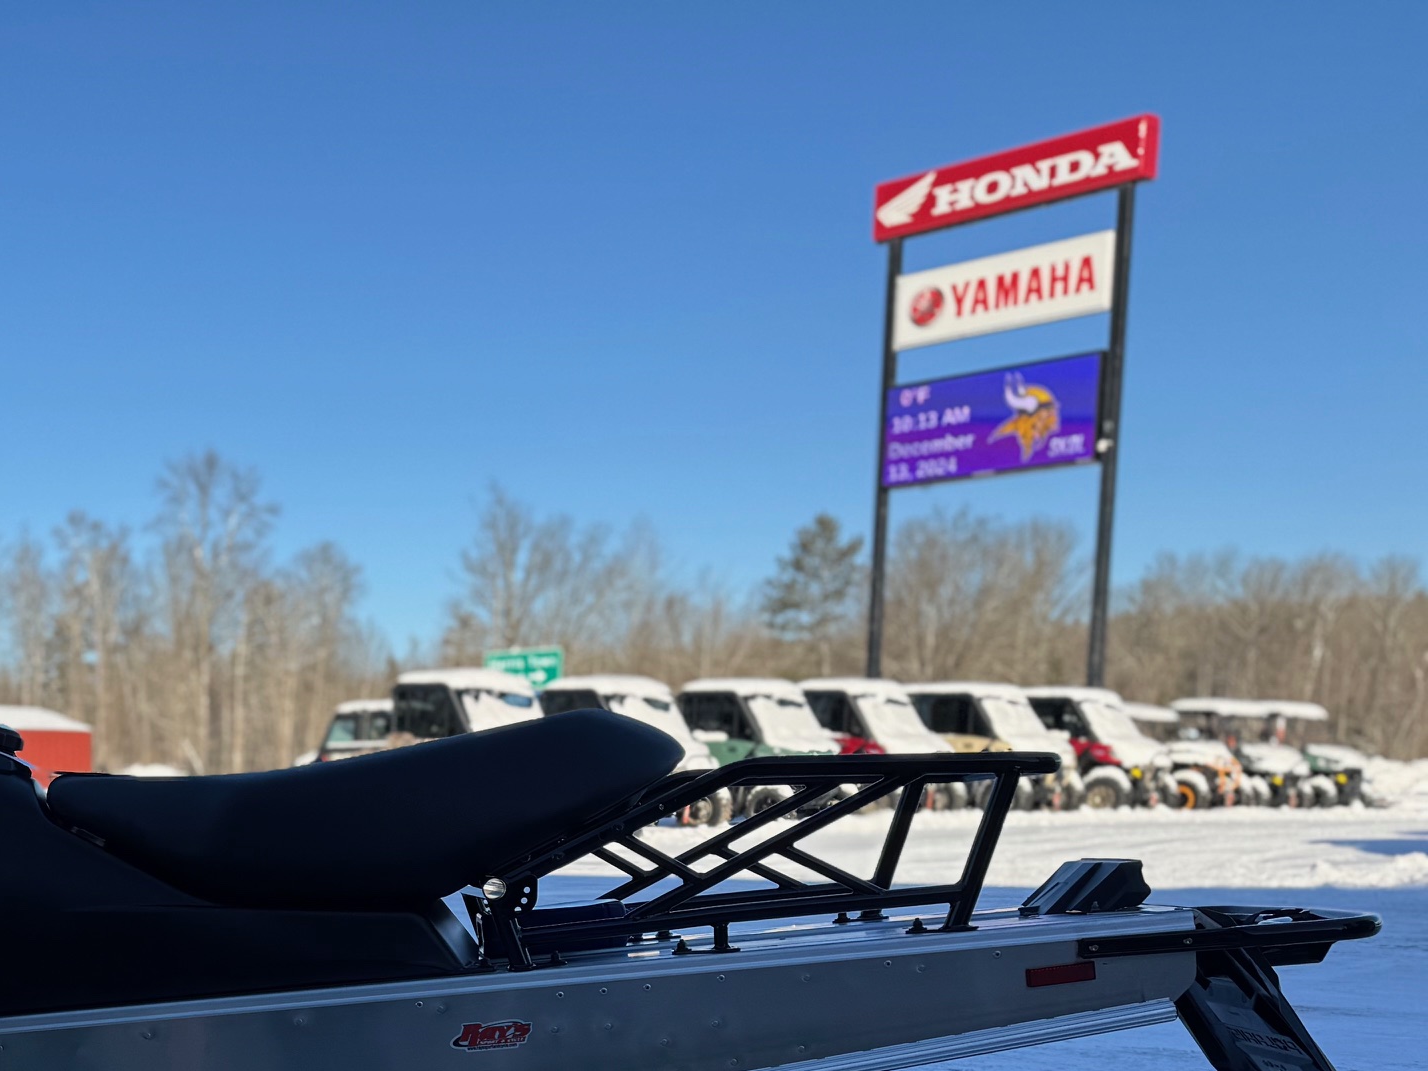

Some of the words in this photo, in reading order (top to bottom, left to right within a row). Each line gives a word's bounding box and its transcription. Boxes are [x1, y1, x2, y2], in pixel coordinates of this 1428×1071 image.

[930, 140, 1139, 216] HONDA
[951, 255, 1095, 317] YAMAHA
[941, 405, 971, 426] AM
[888, 433, 975, 459] December
